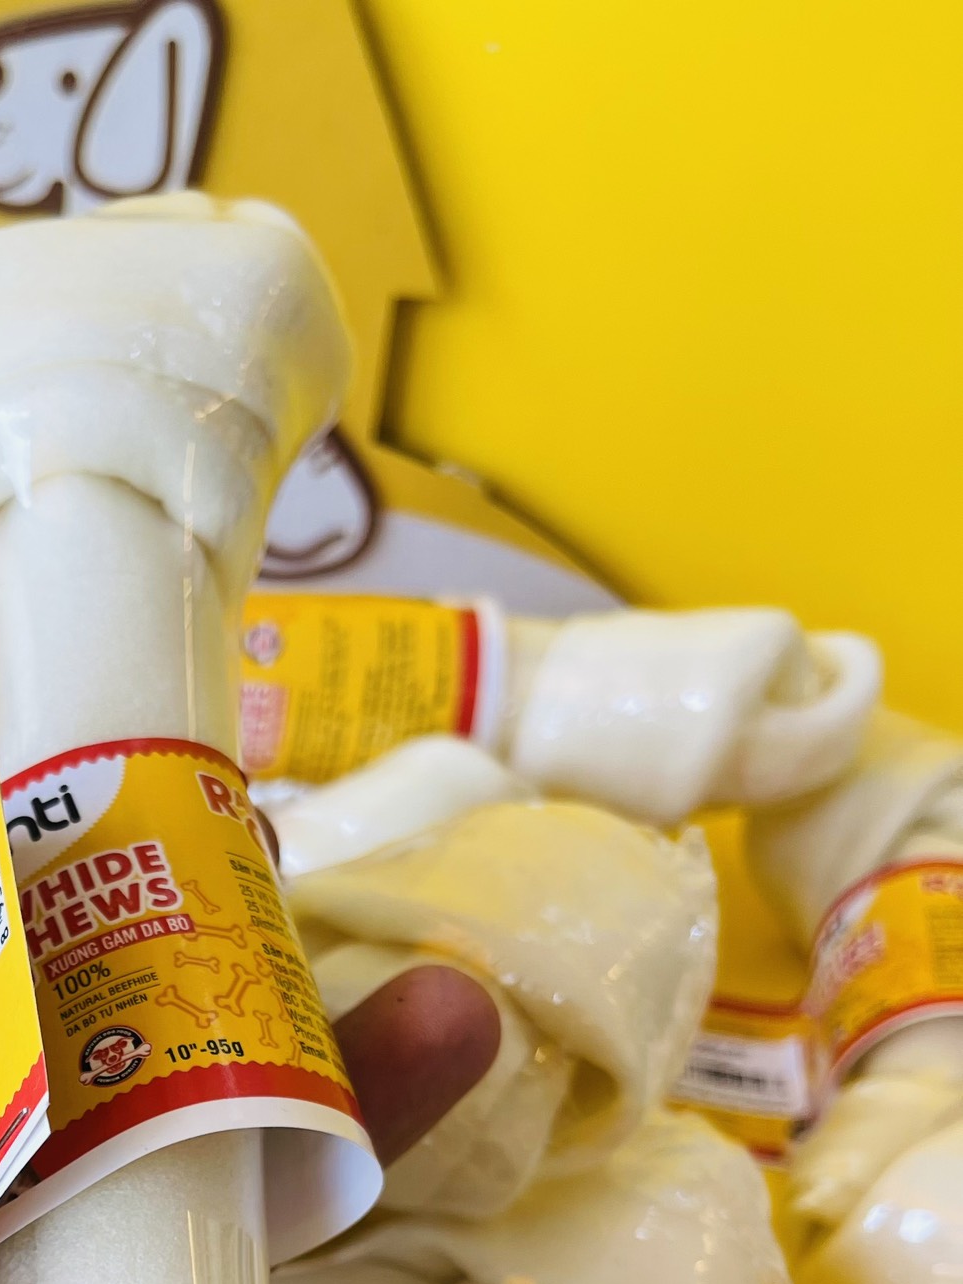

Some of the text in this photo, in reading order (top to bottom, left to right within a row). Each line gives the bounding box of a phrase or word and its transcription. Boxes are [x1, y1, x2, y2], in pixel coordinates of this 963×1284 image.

[7, 785, 81, 842] nti
[0, 927, 9, 945] 8
[141, 920, 164, 938] DA
[168, 914, 190, 931] BÒ
[52, 961, 111, 1001] 100%
[60, 971, 159, 1021] NATURAL BEEFHIDE
[66, 1024, 81, 1037] DA
[82, 1012, 97, 1028] BÒ
[115, 993, 148, 1012] NHIÊN
[165, 1039, 244, 1064] 10"-95g
